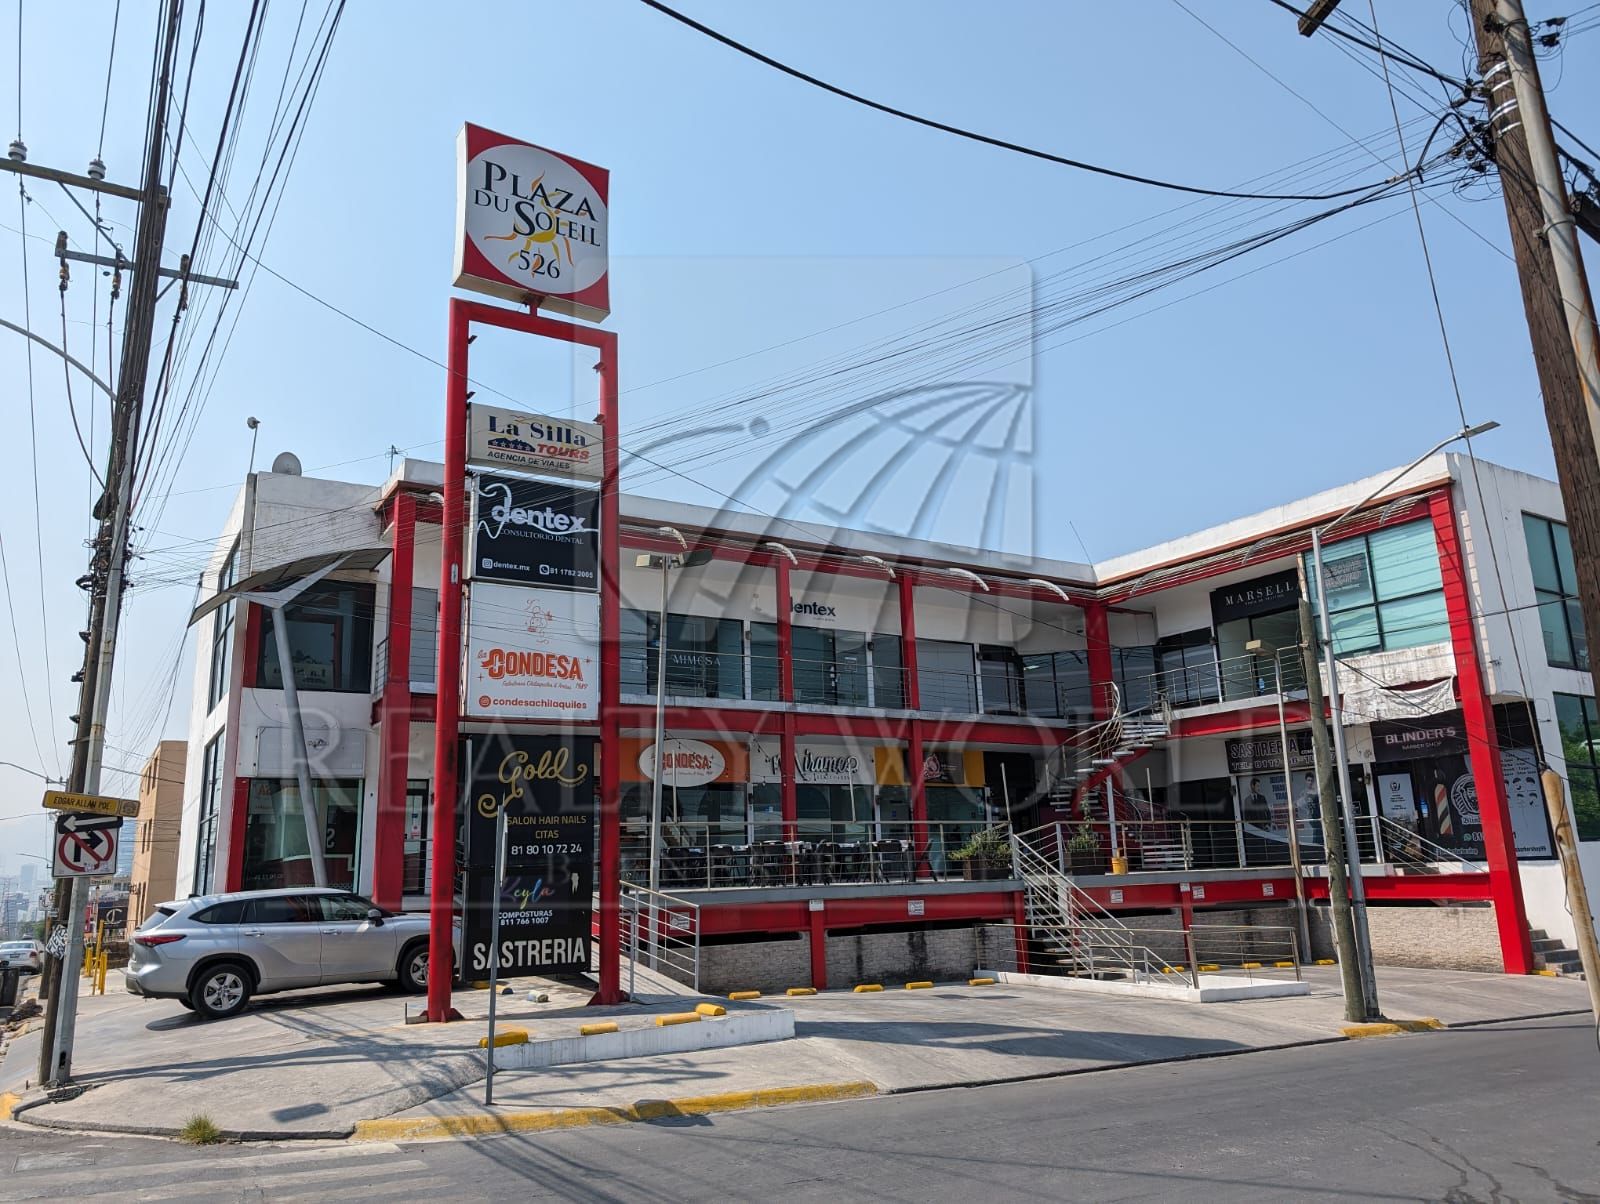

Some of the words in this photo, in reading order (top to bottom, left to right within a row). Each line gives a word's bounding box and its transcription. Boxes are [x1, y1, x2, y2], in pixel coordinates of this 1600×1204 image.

[474, 189, 509, 213] DU
[518, 250, 560, 279] 526
[488, 415, 519, 437] La
[530, 422, 586, 447] Silla
[487, 451, 526, 464] AGENCIA
[528, 457, 540, 466] DE
[541, 459, 570, 469] VIAJES
[537, 443, 590, 460] TOURS
[488, 486, 587, 533] dentex
[500, 527, 554, 541] CONSULTORIO
[555, 534, 584, 545] DENTAL
[493, 561, 531, 572] dentex.mx
[1224, 581, 1299, 606] MARSELL
[790, 596, 836, 617] entex
[482, 648, 584, 681] CONDESA
[493, 697, 587, 711] condesachilaquiles
[1385, 726, 1456, 745] BLINDER'S
[1231, 738, 1298, 759] SASTRERA
[53, 796, 74, 807] EDGAR
[74, 799, 97, 809] ALLAN
[507, 816, 536, 826] SALON
[539, 815, 560, 825] HAIR
[561, 814, 587, 825] NAILS
[535, 830, 560, 839] CITAS
[511, 845, 524, 855] 81
[526, 845, 539, 855] 80
[541, 845, 554, 854] 10
[556, 844, 568, 854] 72
[570, 843, 582, 853] 24
